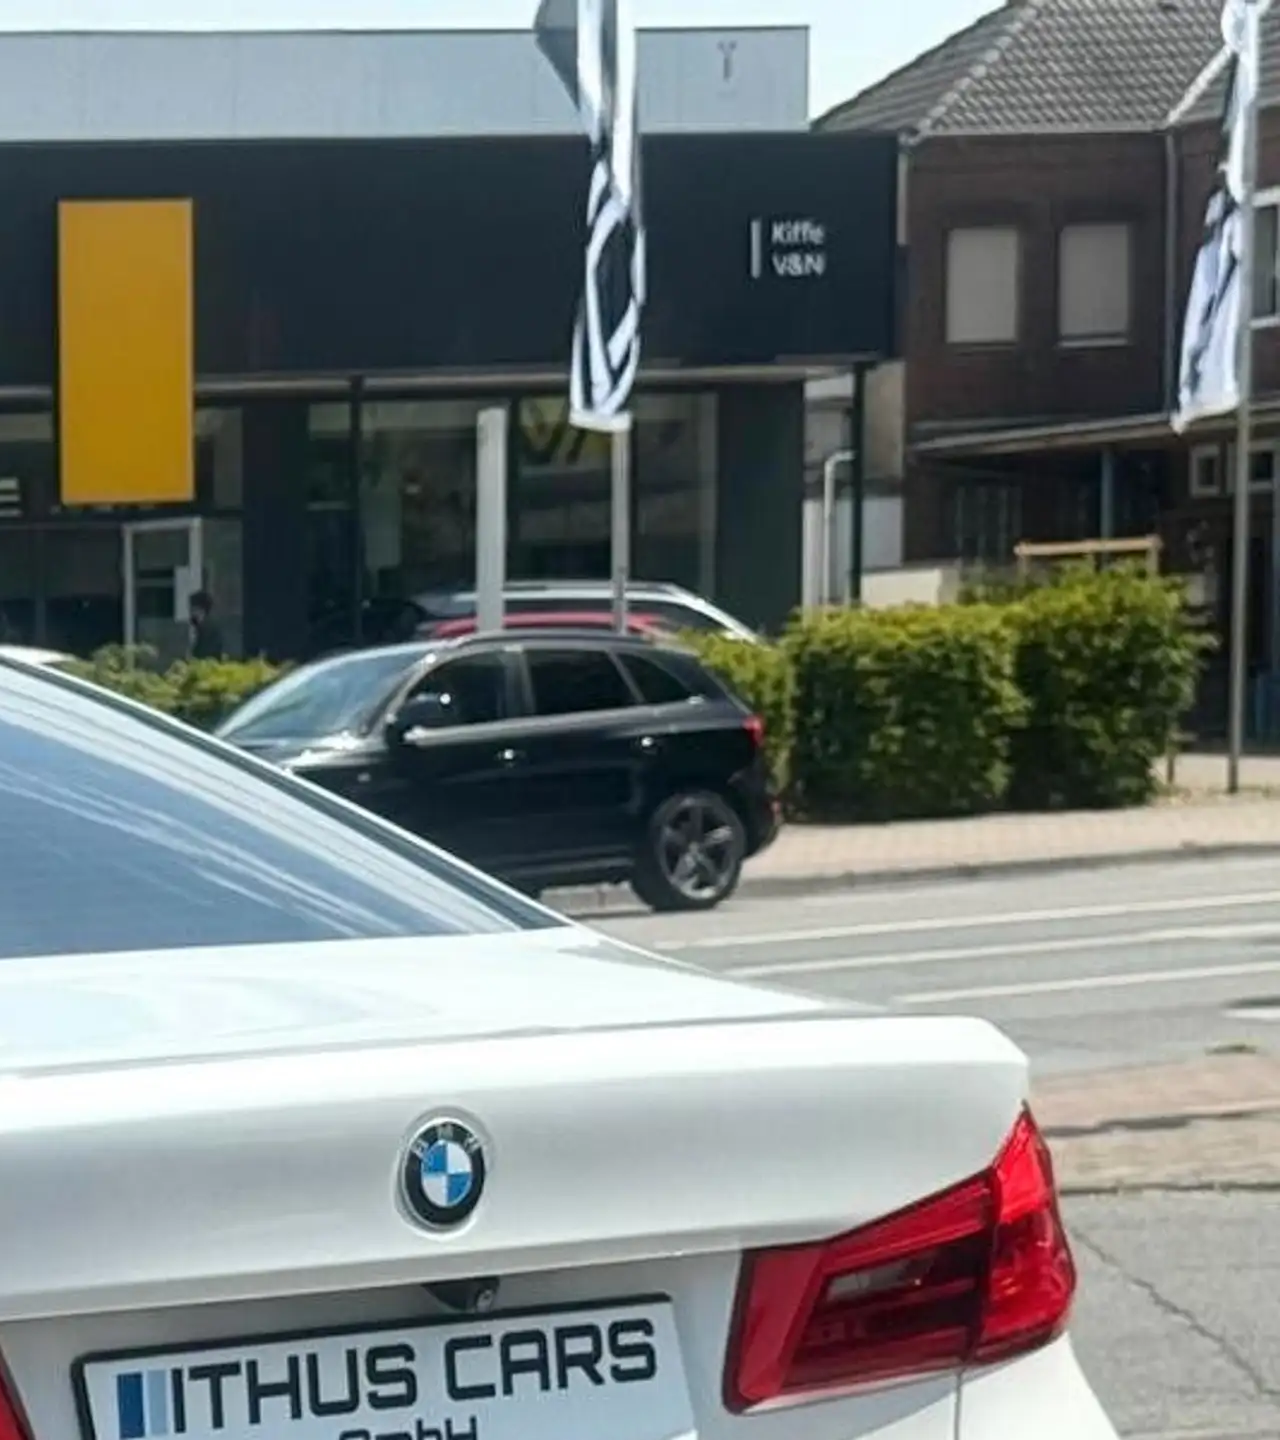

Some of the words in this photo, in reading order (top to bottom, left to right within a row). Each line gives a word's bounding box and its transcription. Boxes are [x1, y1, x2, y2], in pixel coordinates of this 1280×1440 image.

[771, 219, 826, 245] Kiffe
[771, 252, 826, 277] V&N
[444, 1317, 658, 1402] CARS
